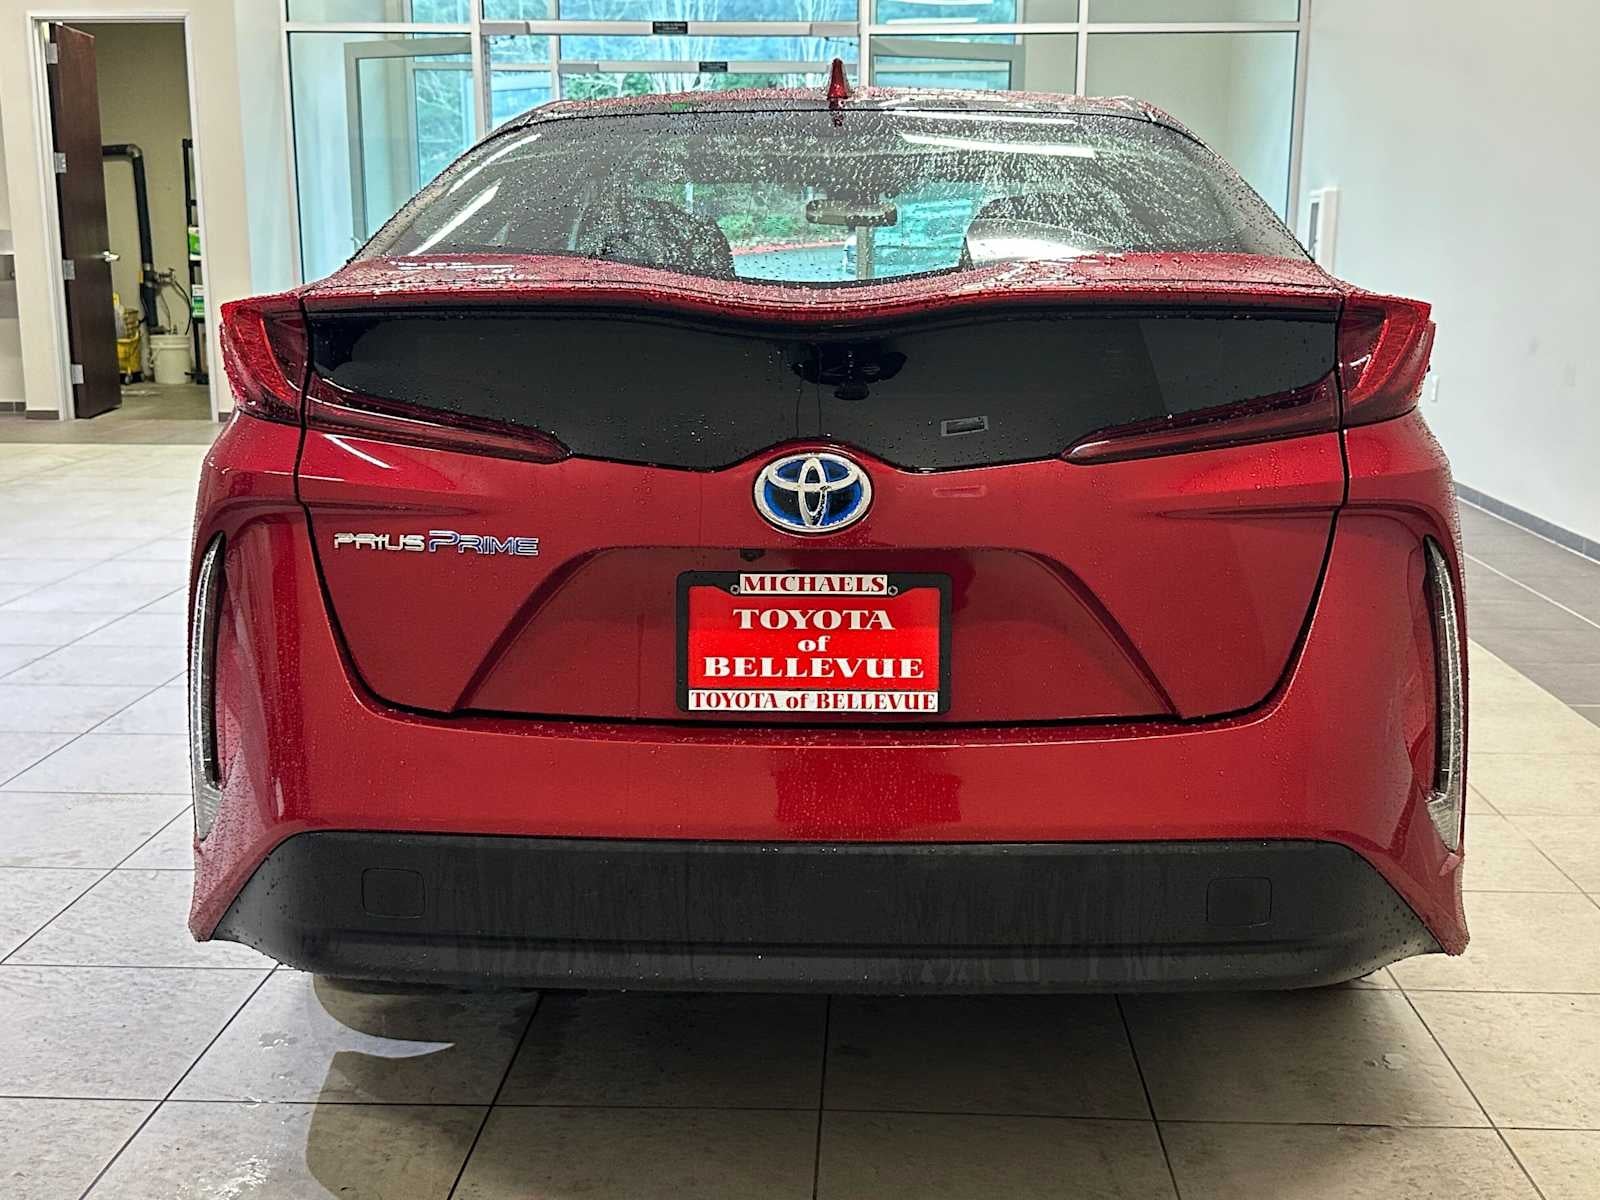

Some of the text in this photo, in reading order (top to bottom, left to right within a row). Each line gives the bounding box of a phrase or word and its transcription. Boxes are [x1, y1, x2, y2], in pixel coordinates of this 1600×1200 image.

[334, 530, 539, 556] PRIUS PRIME
[743, 575, 885, 592] MICHAELS
[733, 609, 896, 630] TOYOTA
[797, 635, 831, 652] of
[703, 656, 924, 679] BELLEVUE
[691, 692, 936, 710] TOYOTA of BELLEVUE
